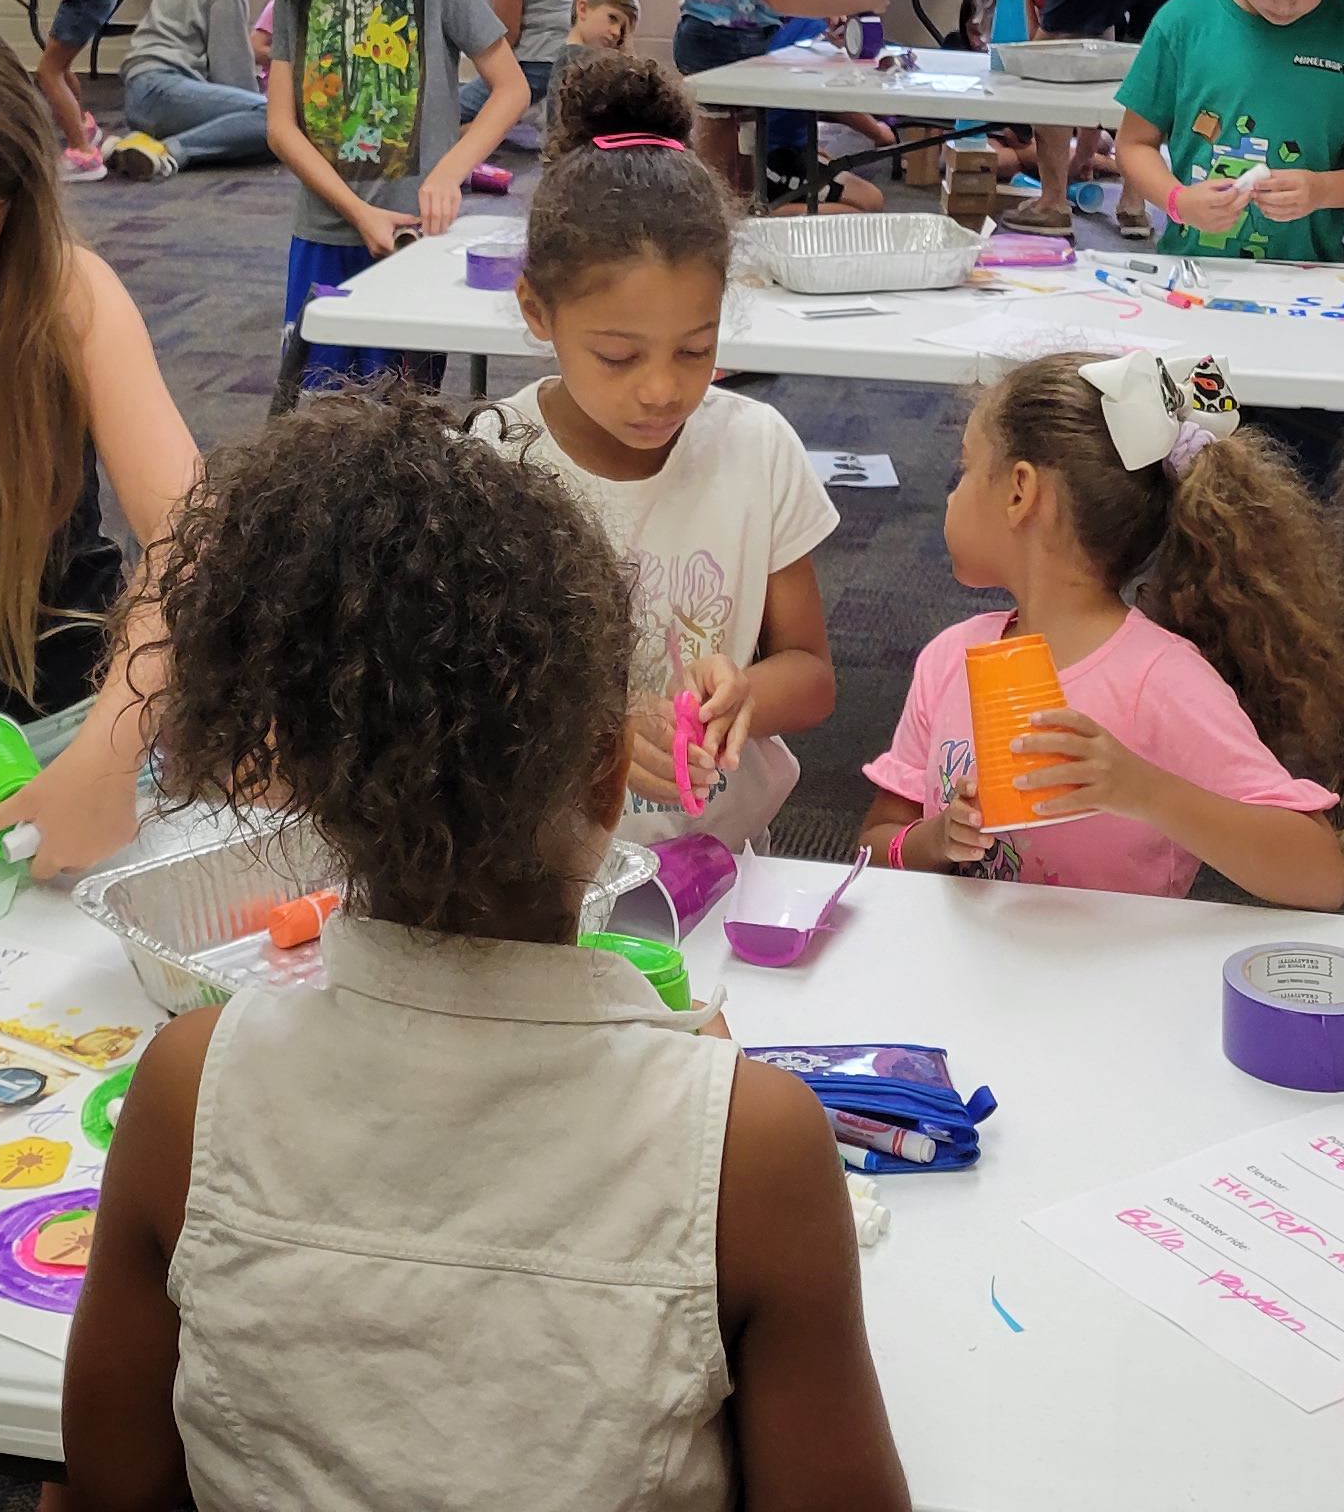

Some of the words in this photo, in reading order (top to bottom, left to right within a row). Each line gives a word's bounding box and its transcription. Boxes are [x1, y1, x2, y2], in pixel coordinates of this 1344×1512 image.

[940, 739, 976, 776] Dr
[1246, 1165, 1289, 1192] Elevator:
[1115, 1208, 1185, 1252] Bella
[1163, 1197, 1191, 1216] Roller
[1191, 1212, 1227, 1239] coaster
[1226, 1232, 1251, 1252] ride:
